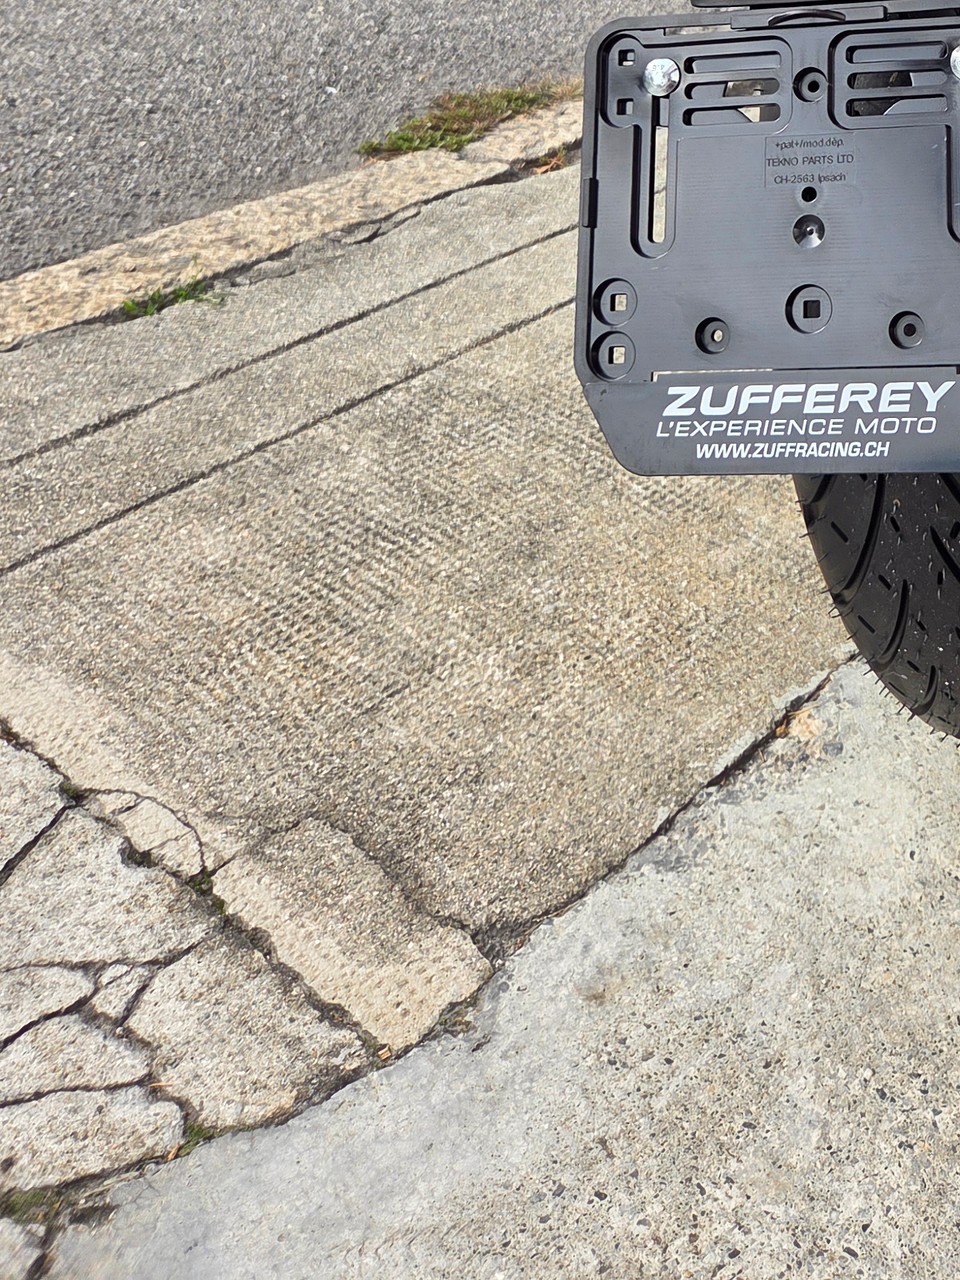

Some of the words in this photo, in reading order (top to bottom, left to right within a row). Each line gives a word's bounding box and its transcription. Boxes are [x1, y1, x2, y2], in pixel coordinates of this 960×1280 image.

[766, 157, 799, 167] TEKNO
[802, 155, 834, 166] PARTS
[836, 153, 854, 163] LTD
[774, 174, 815, 184] CH-2563
[662, 381, 956, 417] ZUFFEREY
[656, 419, 844, 437] L'EXPERIENCE
[854, 417, 937, 435] MOTO
[696, 442, 890, 459] WWW.ZUFFRACING.CH
